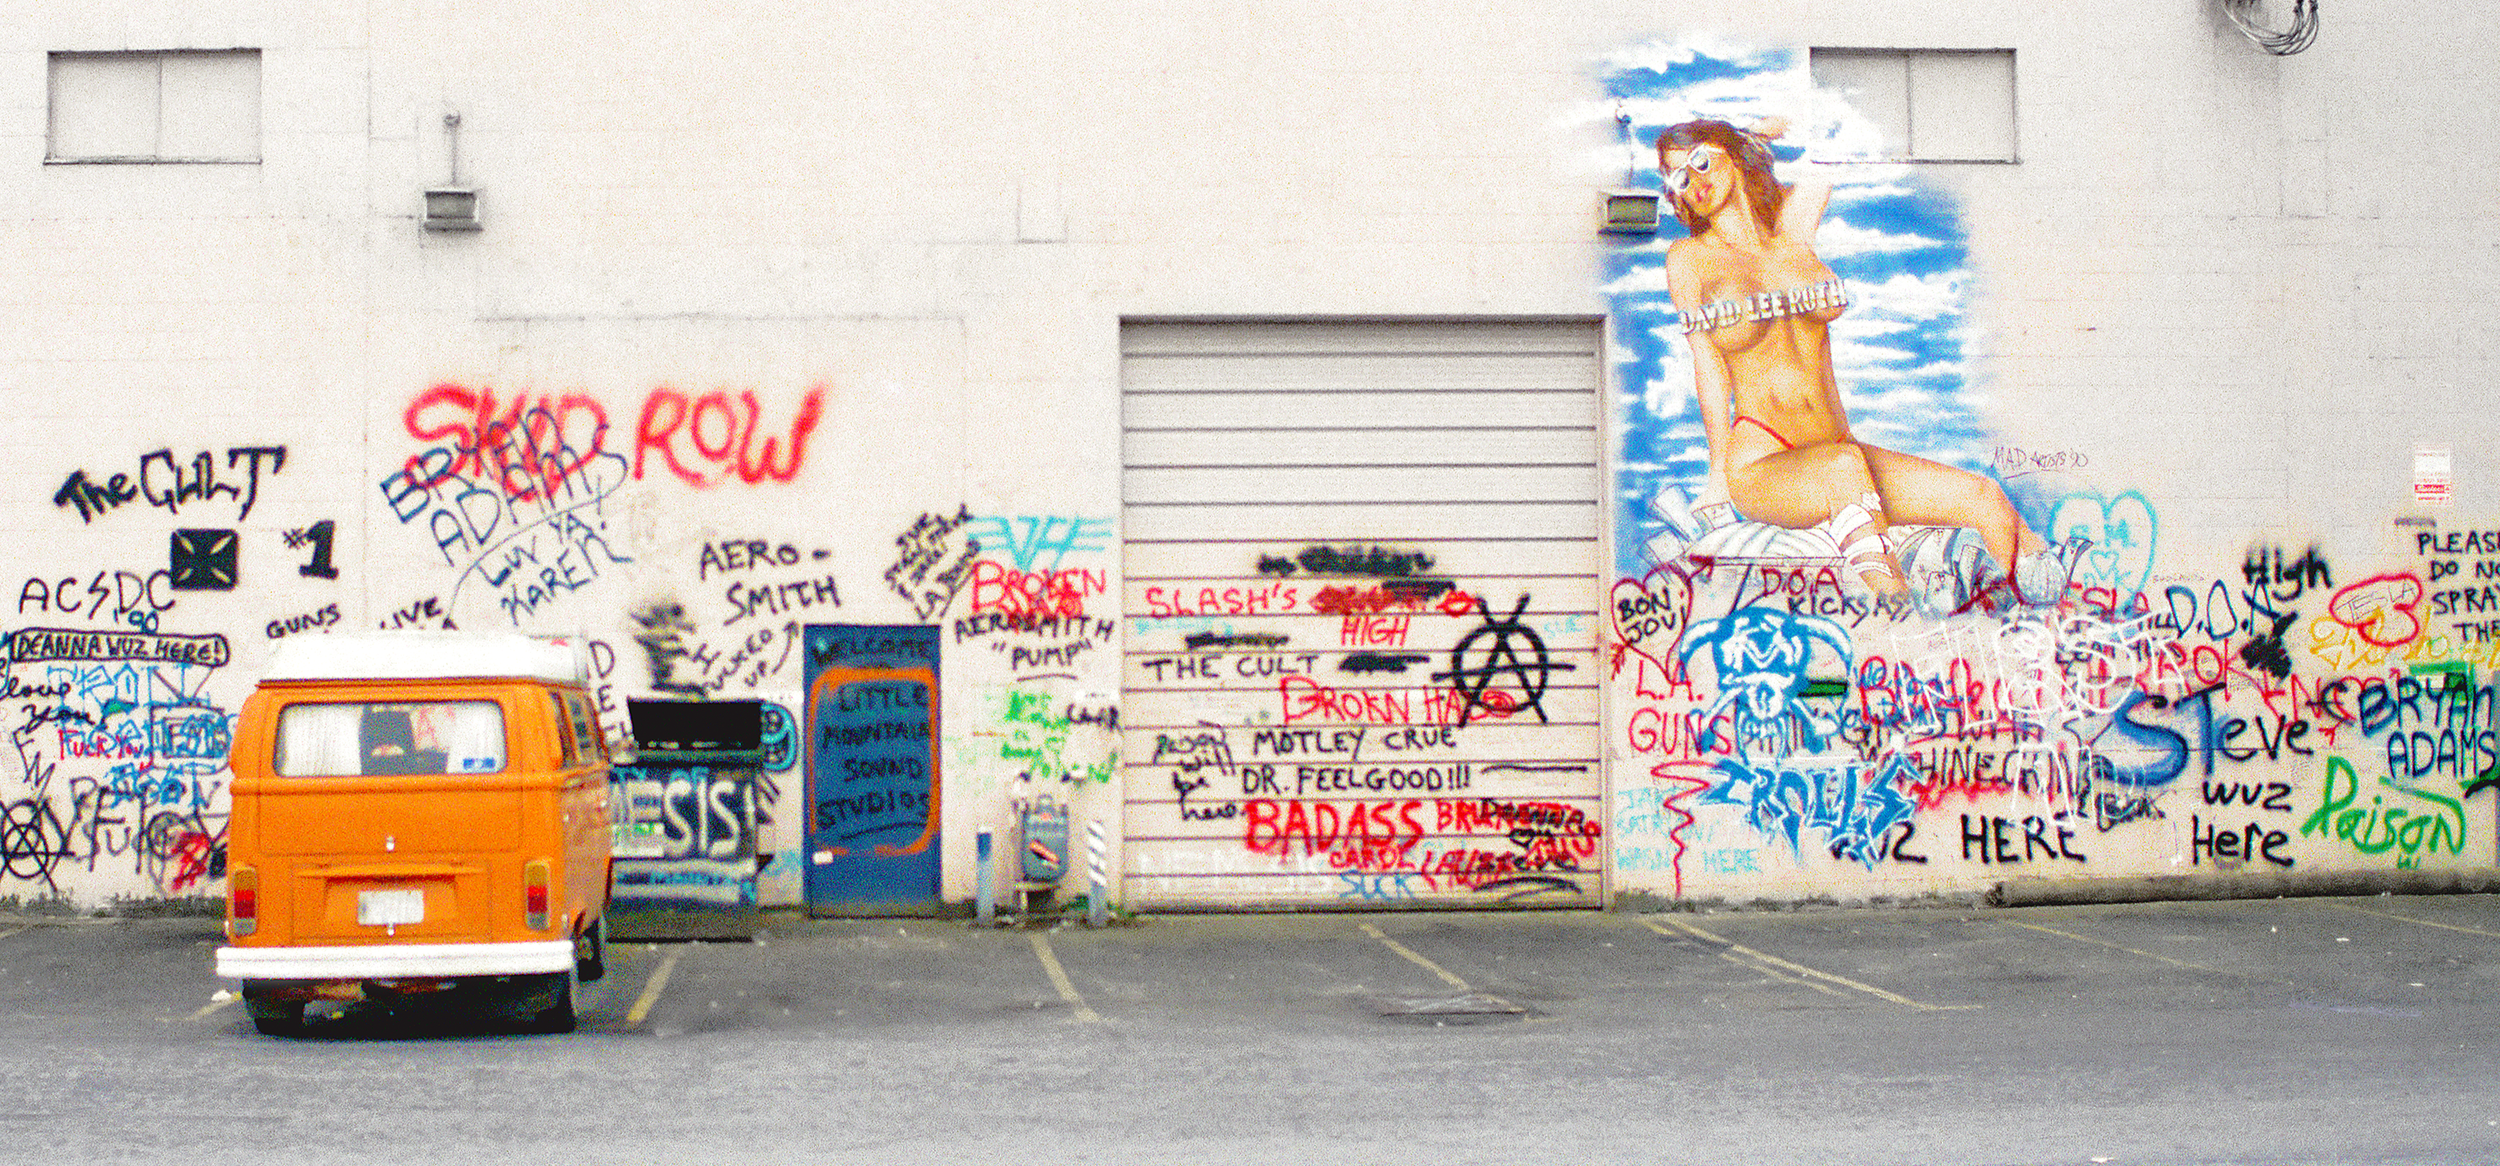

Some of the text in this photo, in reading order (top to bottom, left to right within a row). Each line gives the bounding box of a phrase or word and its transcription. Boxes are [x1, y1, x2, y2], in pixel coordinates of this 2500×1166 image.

[1678, 277, 1849, 335] DAVID LEE ROTH
[633, 380, 830, 488] ROW
[430, 423, 628, 566] ADAMS
[2417, 530, 2500, 556] PLEAS
[2430, 560, 2460, 582] DO
[722, 575, 842, 627] SMITH
[17, 633, 101, 659] DEANNA
[1341, 615, 1410, 647] HIGH
[1142, 654, 1320, 683] THE CULT
[838, 683, 931, 713] LITTLE
[1629, 706, 1731, 758] GUNS
[2388, 727, 2496, 781] ADAMS
[843, 756, 924, 784] SOUND
[816, 789, 932, 831] STUDIOS
[1245, 799, 1425, 858] BADASS
[1960, 811, 2087, 864] HERE
